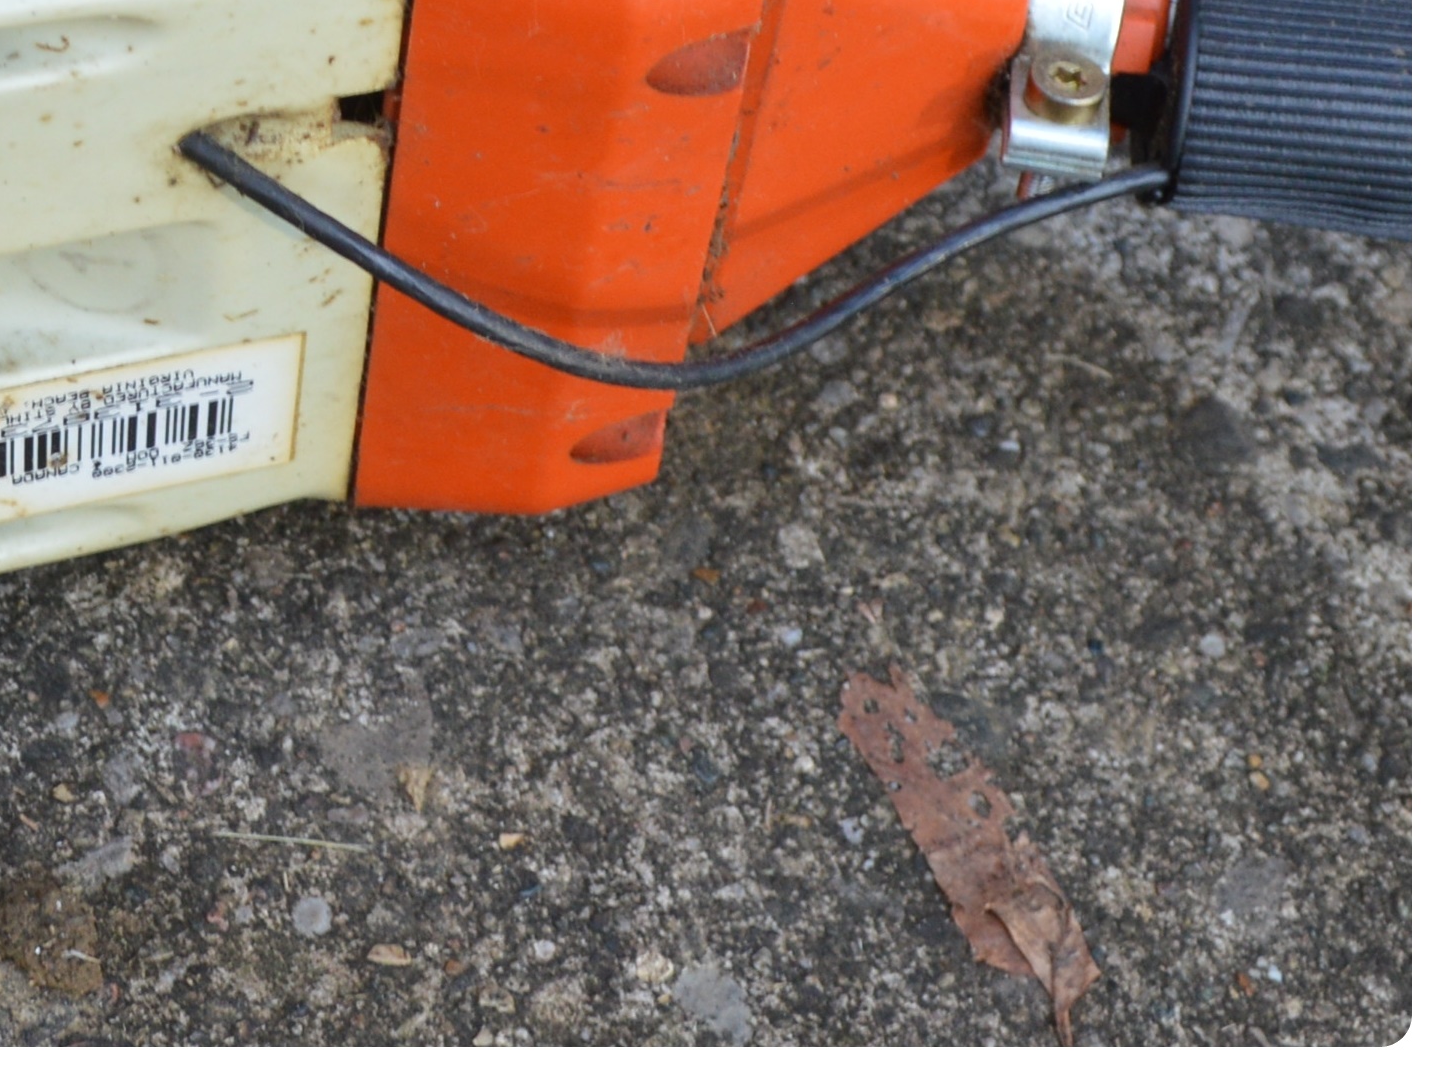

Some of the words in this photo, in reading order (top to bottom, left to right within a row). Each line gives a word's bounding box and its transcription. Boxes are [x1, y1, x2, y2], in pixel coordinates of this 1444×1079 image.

[101, 368, 194, 397] VIRGINIA
[103, 369, 241, 408] MANUFACTURED
[0, 405, 55, 428] STIHL
[68, 398, 90, 414] BY
[11, 461, 79, 486] CANADA
